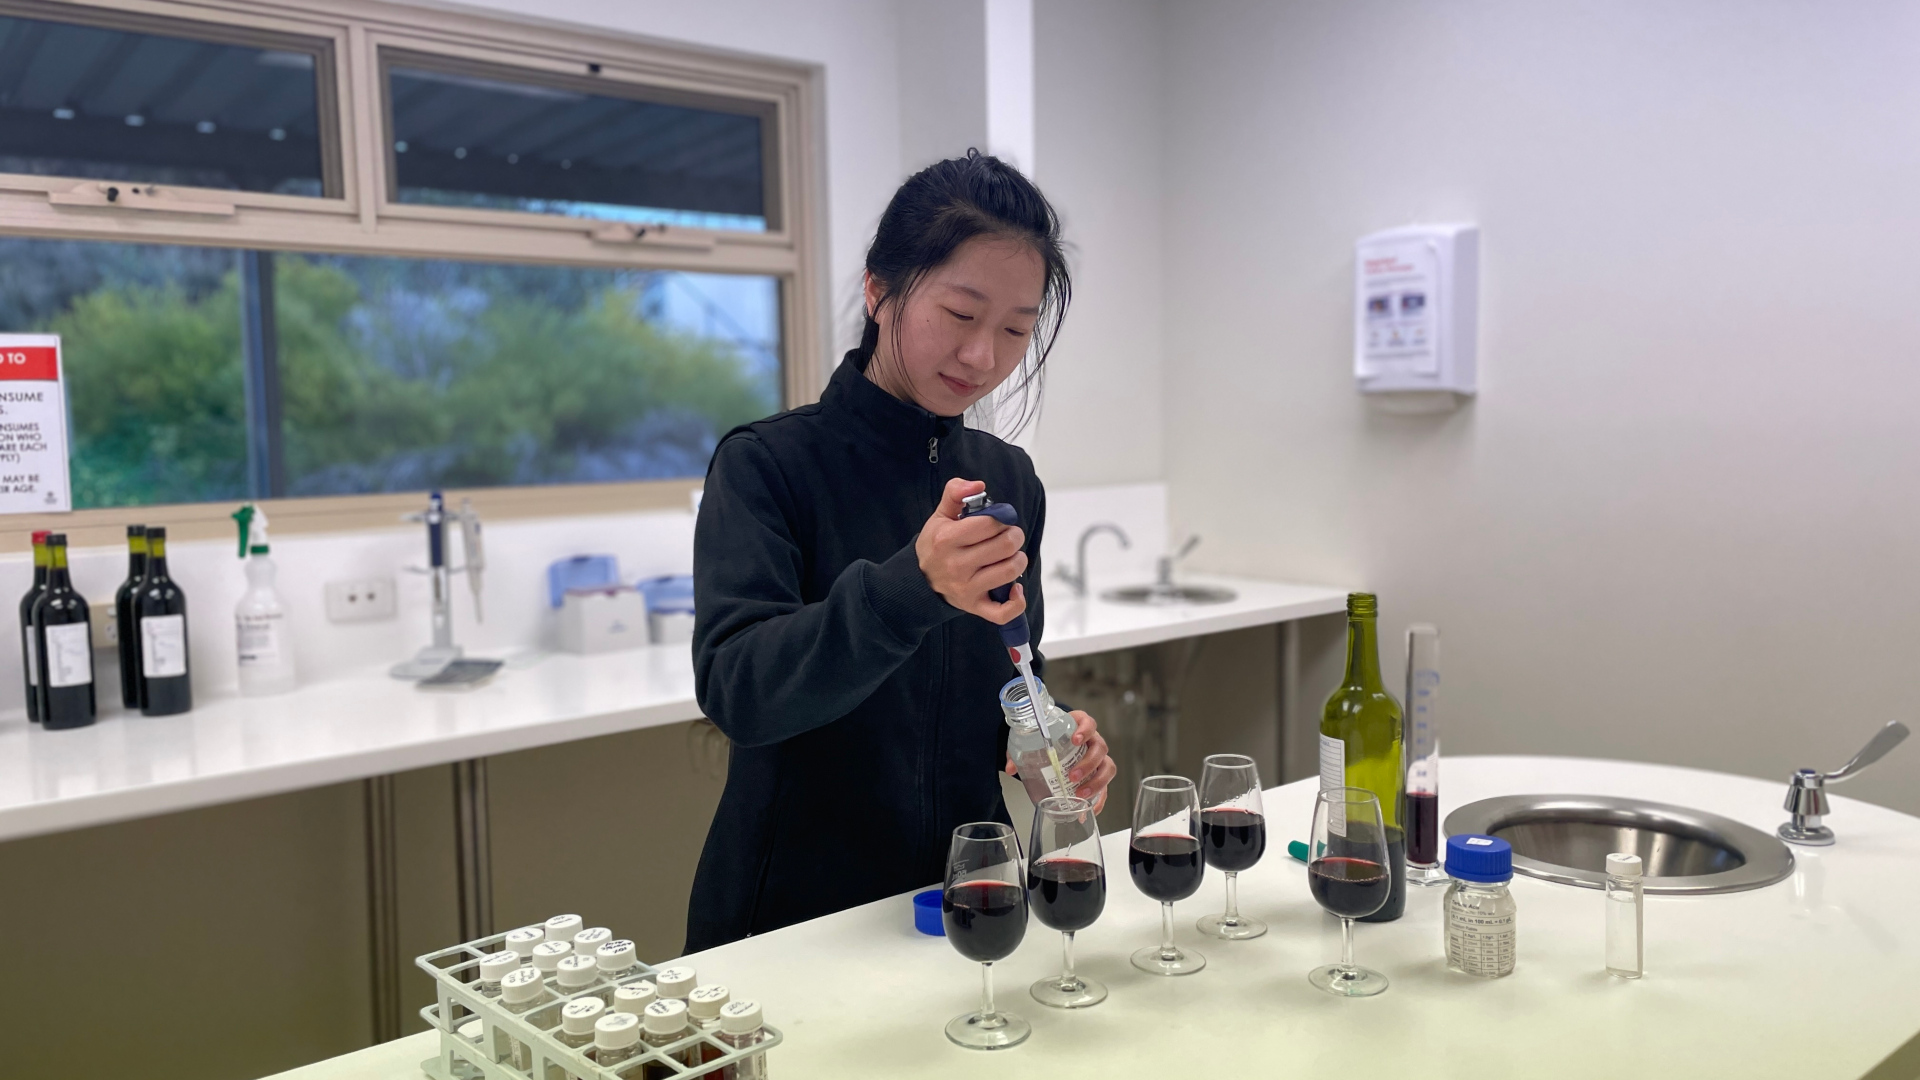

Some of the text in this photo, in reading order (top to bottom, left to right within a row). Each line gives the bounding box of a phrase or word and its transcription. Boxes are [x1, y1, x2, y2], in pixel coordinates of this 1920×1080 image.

[7, 352, 26, 365] TO
[17, 433, 42, 441] WHO
[20, 443, 48, 451] EACH
[3, 474, 40, 483] MAY BE
